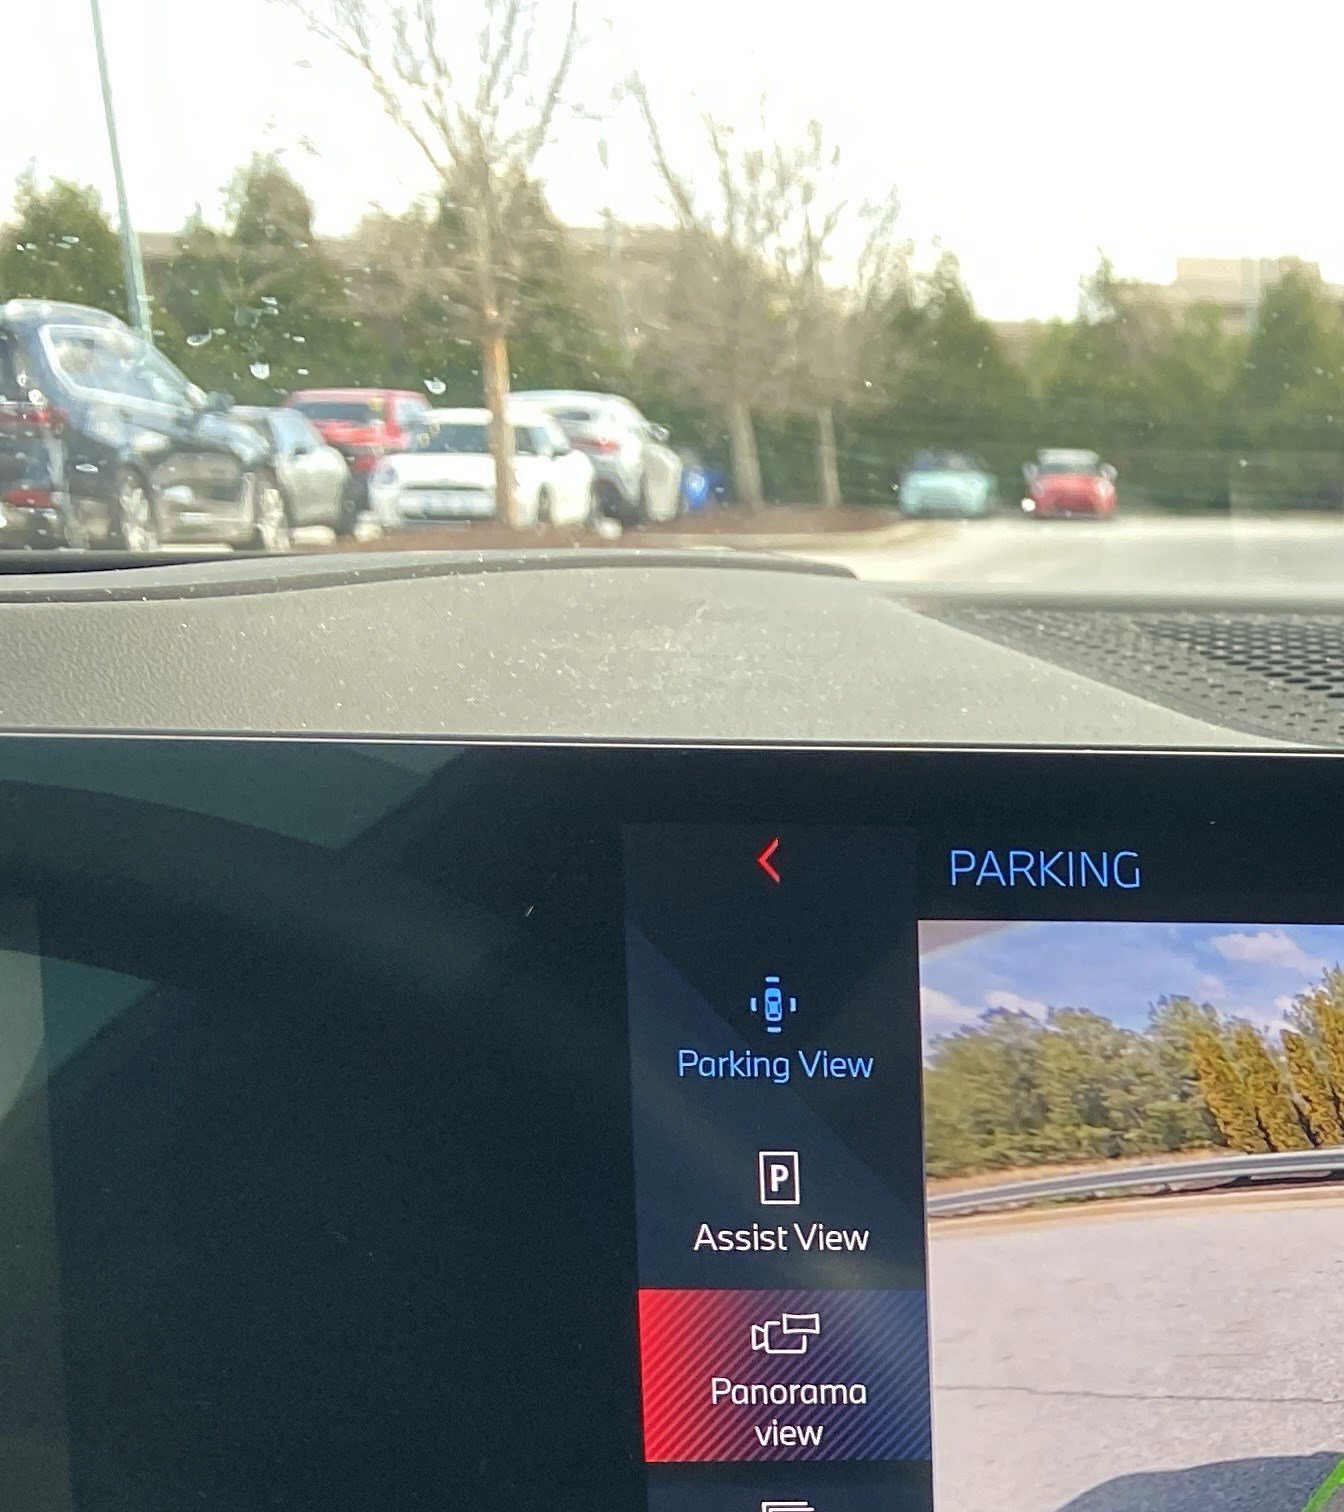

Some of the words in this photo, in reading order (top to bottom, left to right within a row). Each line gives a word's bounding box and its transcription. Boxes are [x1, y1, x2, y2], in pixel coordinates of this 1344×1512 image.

[950, 849, 1141, 889] PARKING
[677, 1048, 791, 1084] Parking
[797, 1050, 875, 1079] View
[769, 1163, 790, 1193] P
[692, 1221, 789, 1252] Assist
[793, 1222, 871, 1252] View
[710, 1377, 868, 1406] Panorama
[754, 1417, 824, 1448] view
